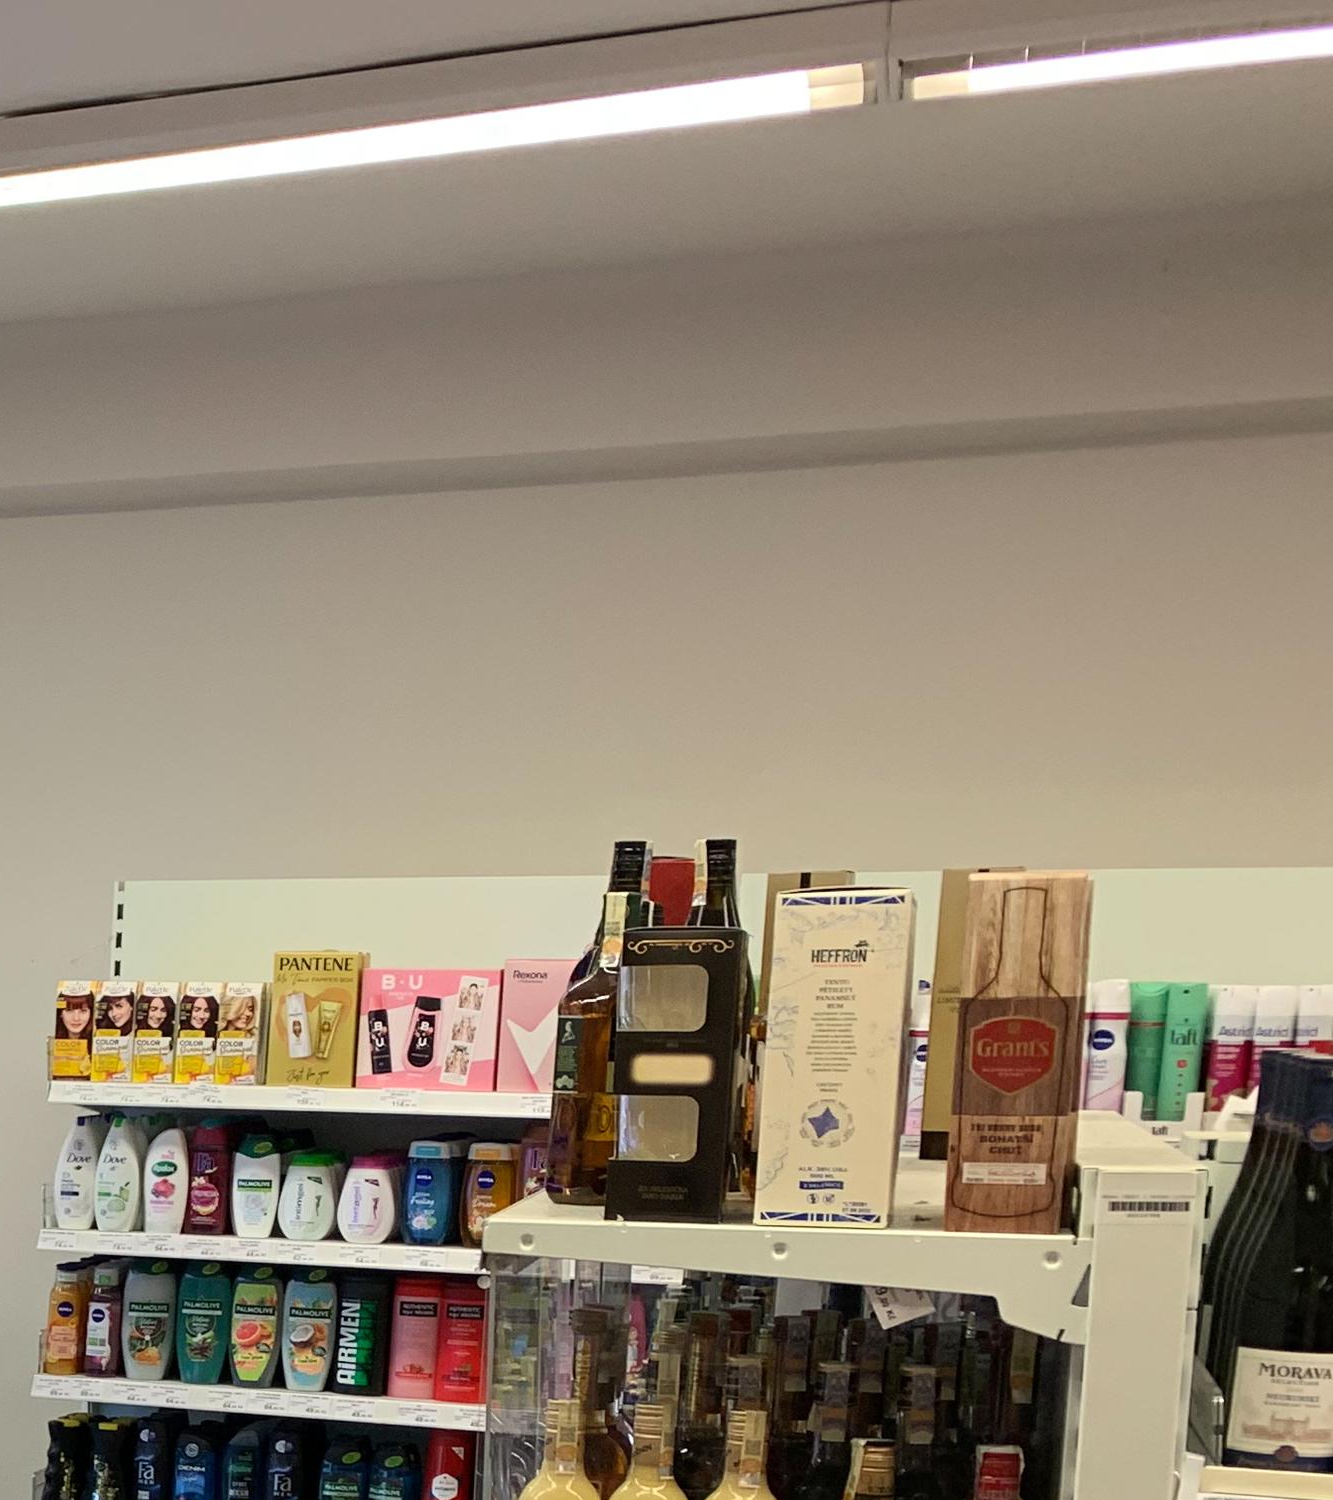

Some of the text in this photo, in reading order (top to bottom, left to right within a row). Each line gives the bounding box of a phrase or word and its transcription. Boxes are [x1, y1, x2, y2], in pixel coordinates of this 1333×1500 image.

[811, 949, 868, 963] HEFFRON
[279, 957, 353, 972] PANTENE
[513, 970, 548, 980] Rexona
[1219, 1026, 1253, 1037] Astrid
[1256, 1026, 1288, 1037] Astrid
[66, 1153, 92, 1164] Dove
[103, 1154, 127, 1164] Dove
[131, 1304, 168, 1312] PALMOLIVE
[184, 1302, 220, 1310] PALMOLIVE
[236, 1305, 274, 1315] PALMOLIVE
[291, 1308, 329, 1318] PALMOLIVE
[138, 1462, 154, 1480] Fa
[178, 1464, 205, 1472] DENIM
[273, 1473, 292, 1492] Fa
